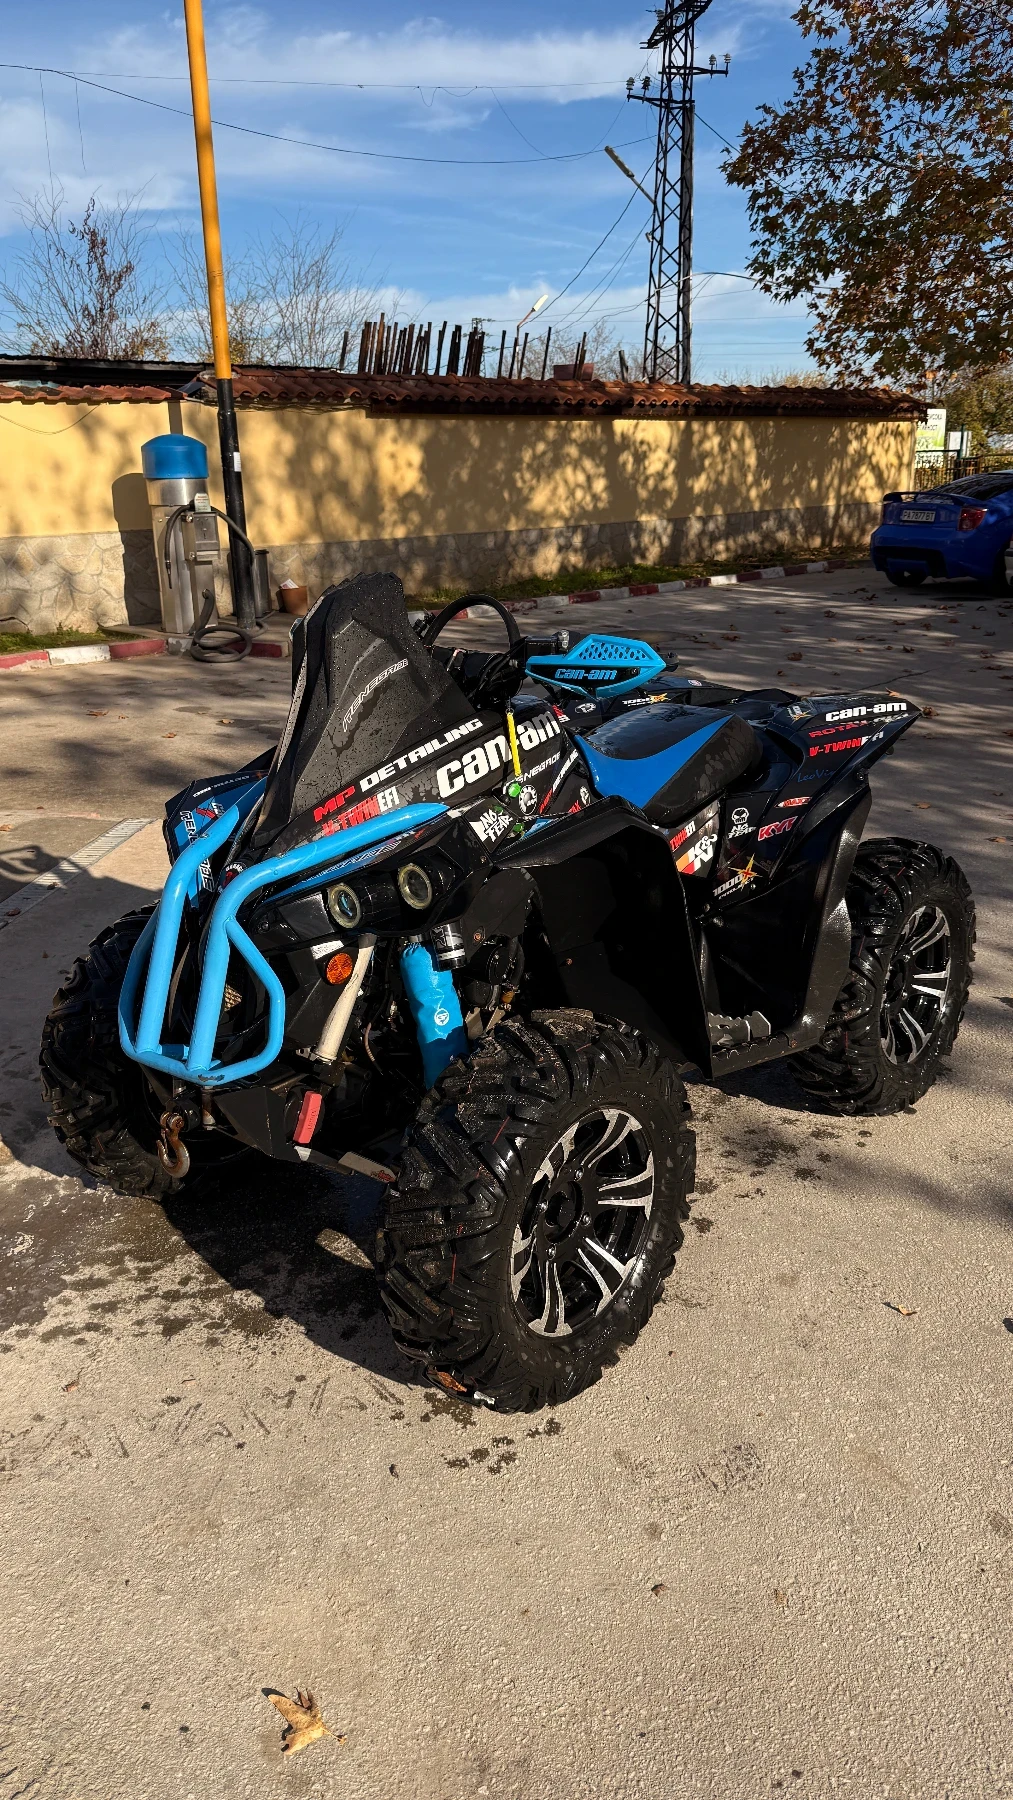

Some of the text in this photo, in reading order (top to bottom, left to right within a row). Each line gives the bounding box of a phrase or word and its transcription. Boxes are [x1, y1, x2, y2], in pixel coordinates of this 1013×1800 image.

[554, 668, 618, 680] can-am
[342, 658, 409, 733] RENEGADE
[825, 702, 908, 722] can-am
[313, 785, 356, 823] MP
[359, 718, 484, 793] DETAILING
[479, 808, 498, 829] NO
[484, 813, 514, 843] FEAR
[687, 833, 719, 872] K&N
